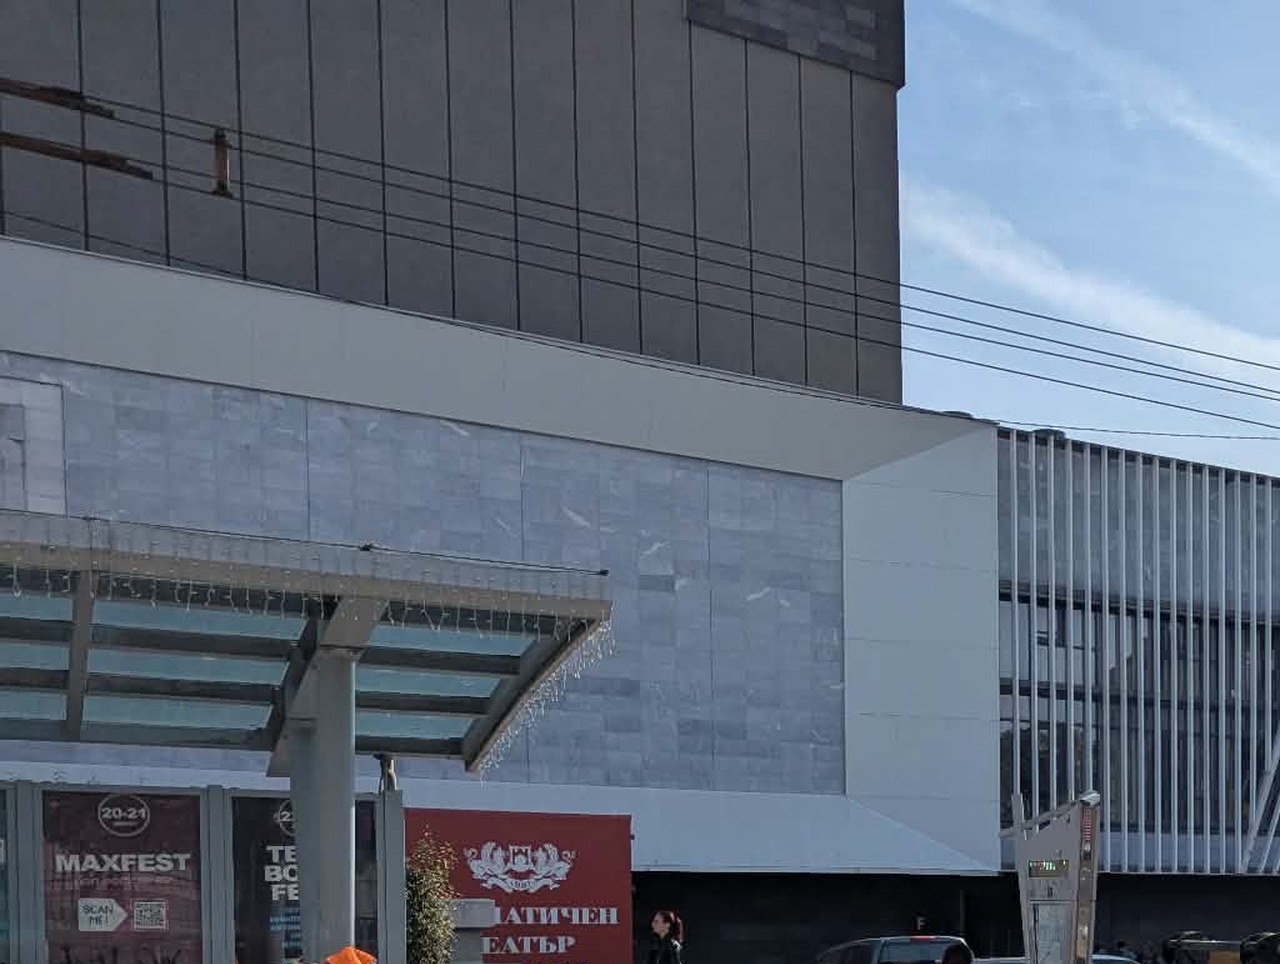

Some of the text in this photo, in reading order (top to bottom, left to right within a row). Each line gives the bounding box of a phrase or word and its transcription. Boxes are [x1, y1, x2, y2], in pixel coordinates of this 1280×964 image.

[101, 807, 146, 819] 20-21
[266, 845, 298, 862] TE
[55, 853, 191, 873] MAXFEST
[264, 865, 300, 882] BO
[271, 884, 300, 901] FE
[83, 904, 114, 915] SCAN
[494, 906, 620, 925] АТИЧЕН
[480, 936, 576, 954] ЕАТЪР
